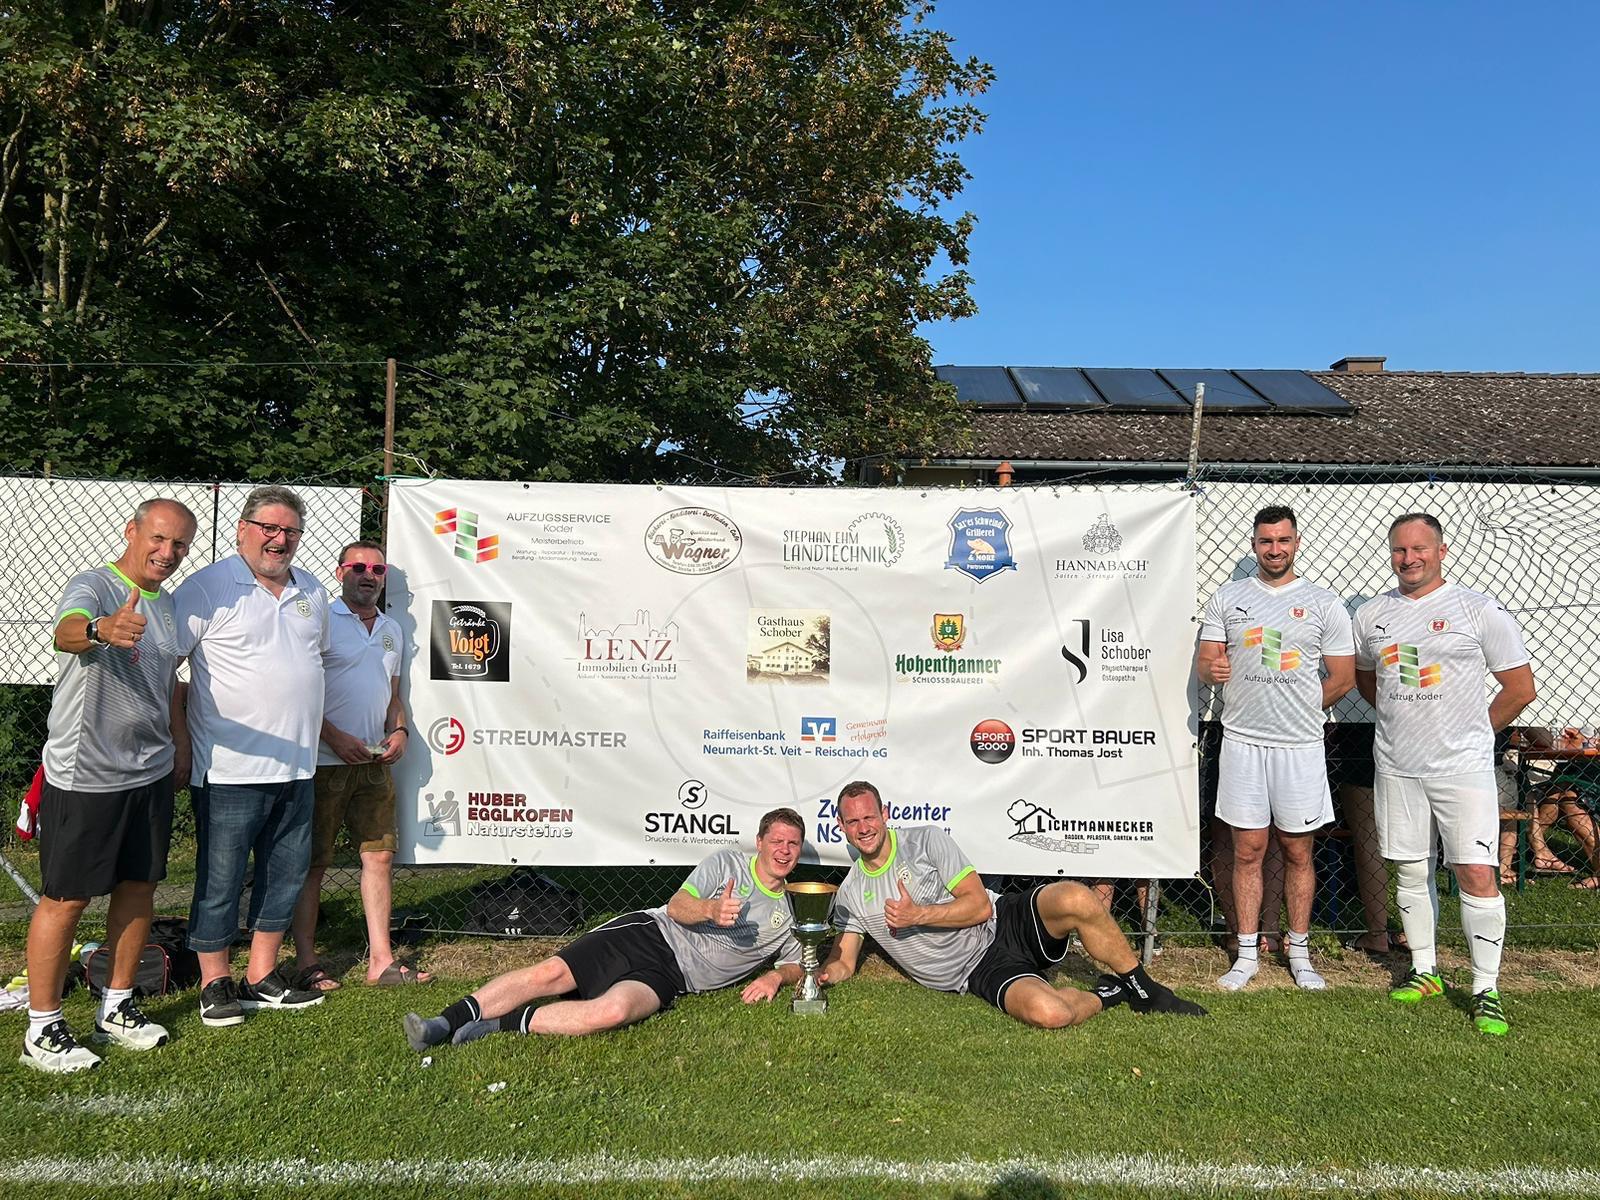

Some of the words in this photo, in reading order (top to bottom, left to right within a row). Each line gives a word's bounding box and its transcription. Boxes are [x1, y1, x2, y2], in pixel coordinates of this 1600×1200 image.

[506, 512, 611, 524] AUFZUGSSERVICE
[702, 510, 728, 528] Dorfladen
[543, 524, 574, 533] Koder
[966, 528, 994, 536] Grillerei
[783, 530, 832, 544] STEPHAN
[836, 531, 860, 544] EHM
[660, 542, 730, 563] Wagner
[784, 544, 888, 562] LANDTECHNIK
[1056, 560, 1146, 571] HANNABACH
[449, 616, 486, 628] Getränke
[757, 616, 804, 626] Gasthaus
[760, 627, 802, 638] Schober
[1102, 628, 1124, 642] Lisa
[449, 630, 490, 662] Voigt
[584, 639, 672, 661] LENZ
[1102, 646, 1152, 660] Schober
[578, 662, 638, 672] Immobilien
[642, 663, 676, 672] GmbH
[896, 654, 1002, 676] Hohenthanner
[912, 676, 984, 684] SCHLOSSBRAUEREI
[1244, 674, 1272, 684] Aufzug
[1274, 676, 1298, 684] Koder
[1416, 692, 1442, 700] Koder
[472, 730, 626, 748] STREUMASTER
[703, 730, 786, 741] Raiffeisenbank
[974, 732, 1012, 742] SPORT
[1022, 729, 1088, 744] SPORT
[1092, 730, 1156, 745] BAUER
[703, 744, 776, 756] Neumarkt-St.
[780, 746, 802, 756] Veit
[815, 746, 869, 758] Reischach
[872, 748, 888, 758] eG
[977, 742, 1008, 751] 2000
[1022, 746, 1044, 757] Inh.
[1046, 747, 1094, 758] Thomas
[1097, 748, 1123, 758] Jost
[468, 792, 526, 806] HUBER
[468, 808, 573, 822] EGGLKOFEN
[467, 822, 573, 838] Natursteine
[645, 812, 740, 834] STANGL
[1037, 816, 1154, 832] LICHTMANNECKER
[645, 834, 678, 844] Druckerei
[690, 836, 740, 846] Werbetechnik
